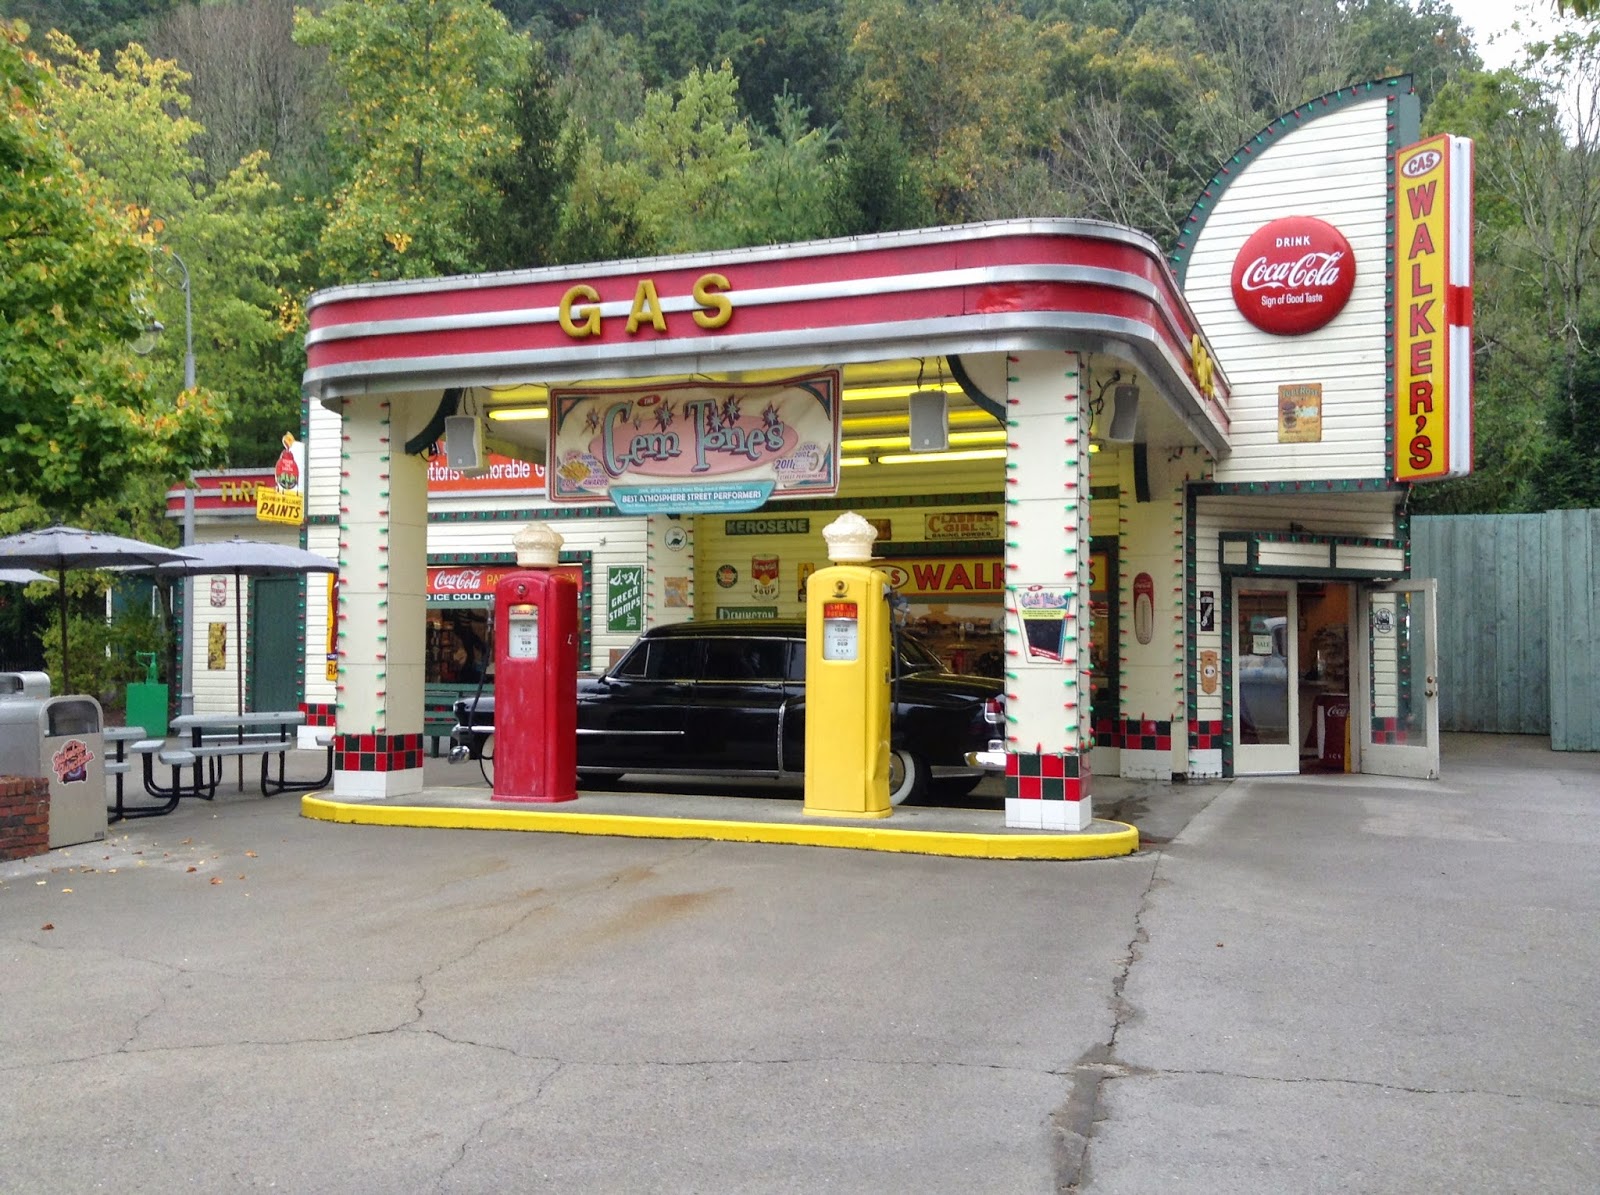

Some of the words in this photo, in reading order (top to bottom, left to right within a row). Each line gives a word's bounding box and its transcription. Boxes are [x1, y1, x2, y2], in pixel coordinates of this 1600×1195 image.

[1408, 153, 1434, 174] CAS
[1275, 236, 1311, 247] DRINK
[1241, 251, 1345, 291] Coca-Cola
[558, 272, 733, 338] GAS
[1261, 295, 1276, 308] Sign
[1277, 294, 1285, 305] of
[1286, 293, 1304, 304] Good
[1305, 292, 1323, 303] Taste
[1407, 179, 1438, 470] WALKER'S
[602, 401, 682, 478] Gem
[683, 399, 785, 473] Tones
[622, 494, 638, 503] BEST
[639, 493, 686, 502] ATMOSPHERE
[687, 492, 712, 501] STREET
[713, 490, 762, 500] PERFORMERS
[259, 502, 301, 518] PAINTS
[726, 519, 808, 533] KEROSENE
[943, 523, 977, 532] GIRL
[433, 570, 485, 590] Coca-Cola
[453, 593, 481, 601] COLD
[611, 586, 638, 608] GREEN
[609, 596, 641, 622] STAMPS
